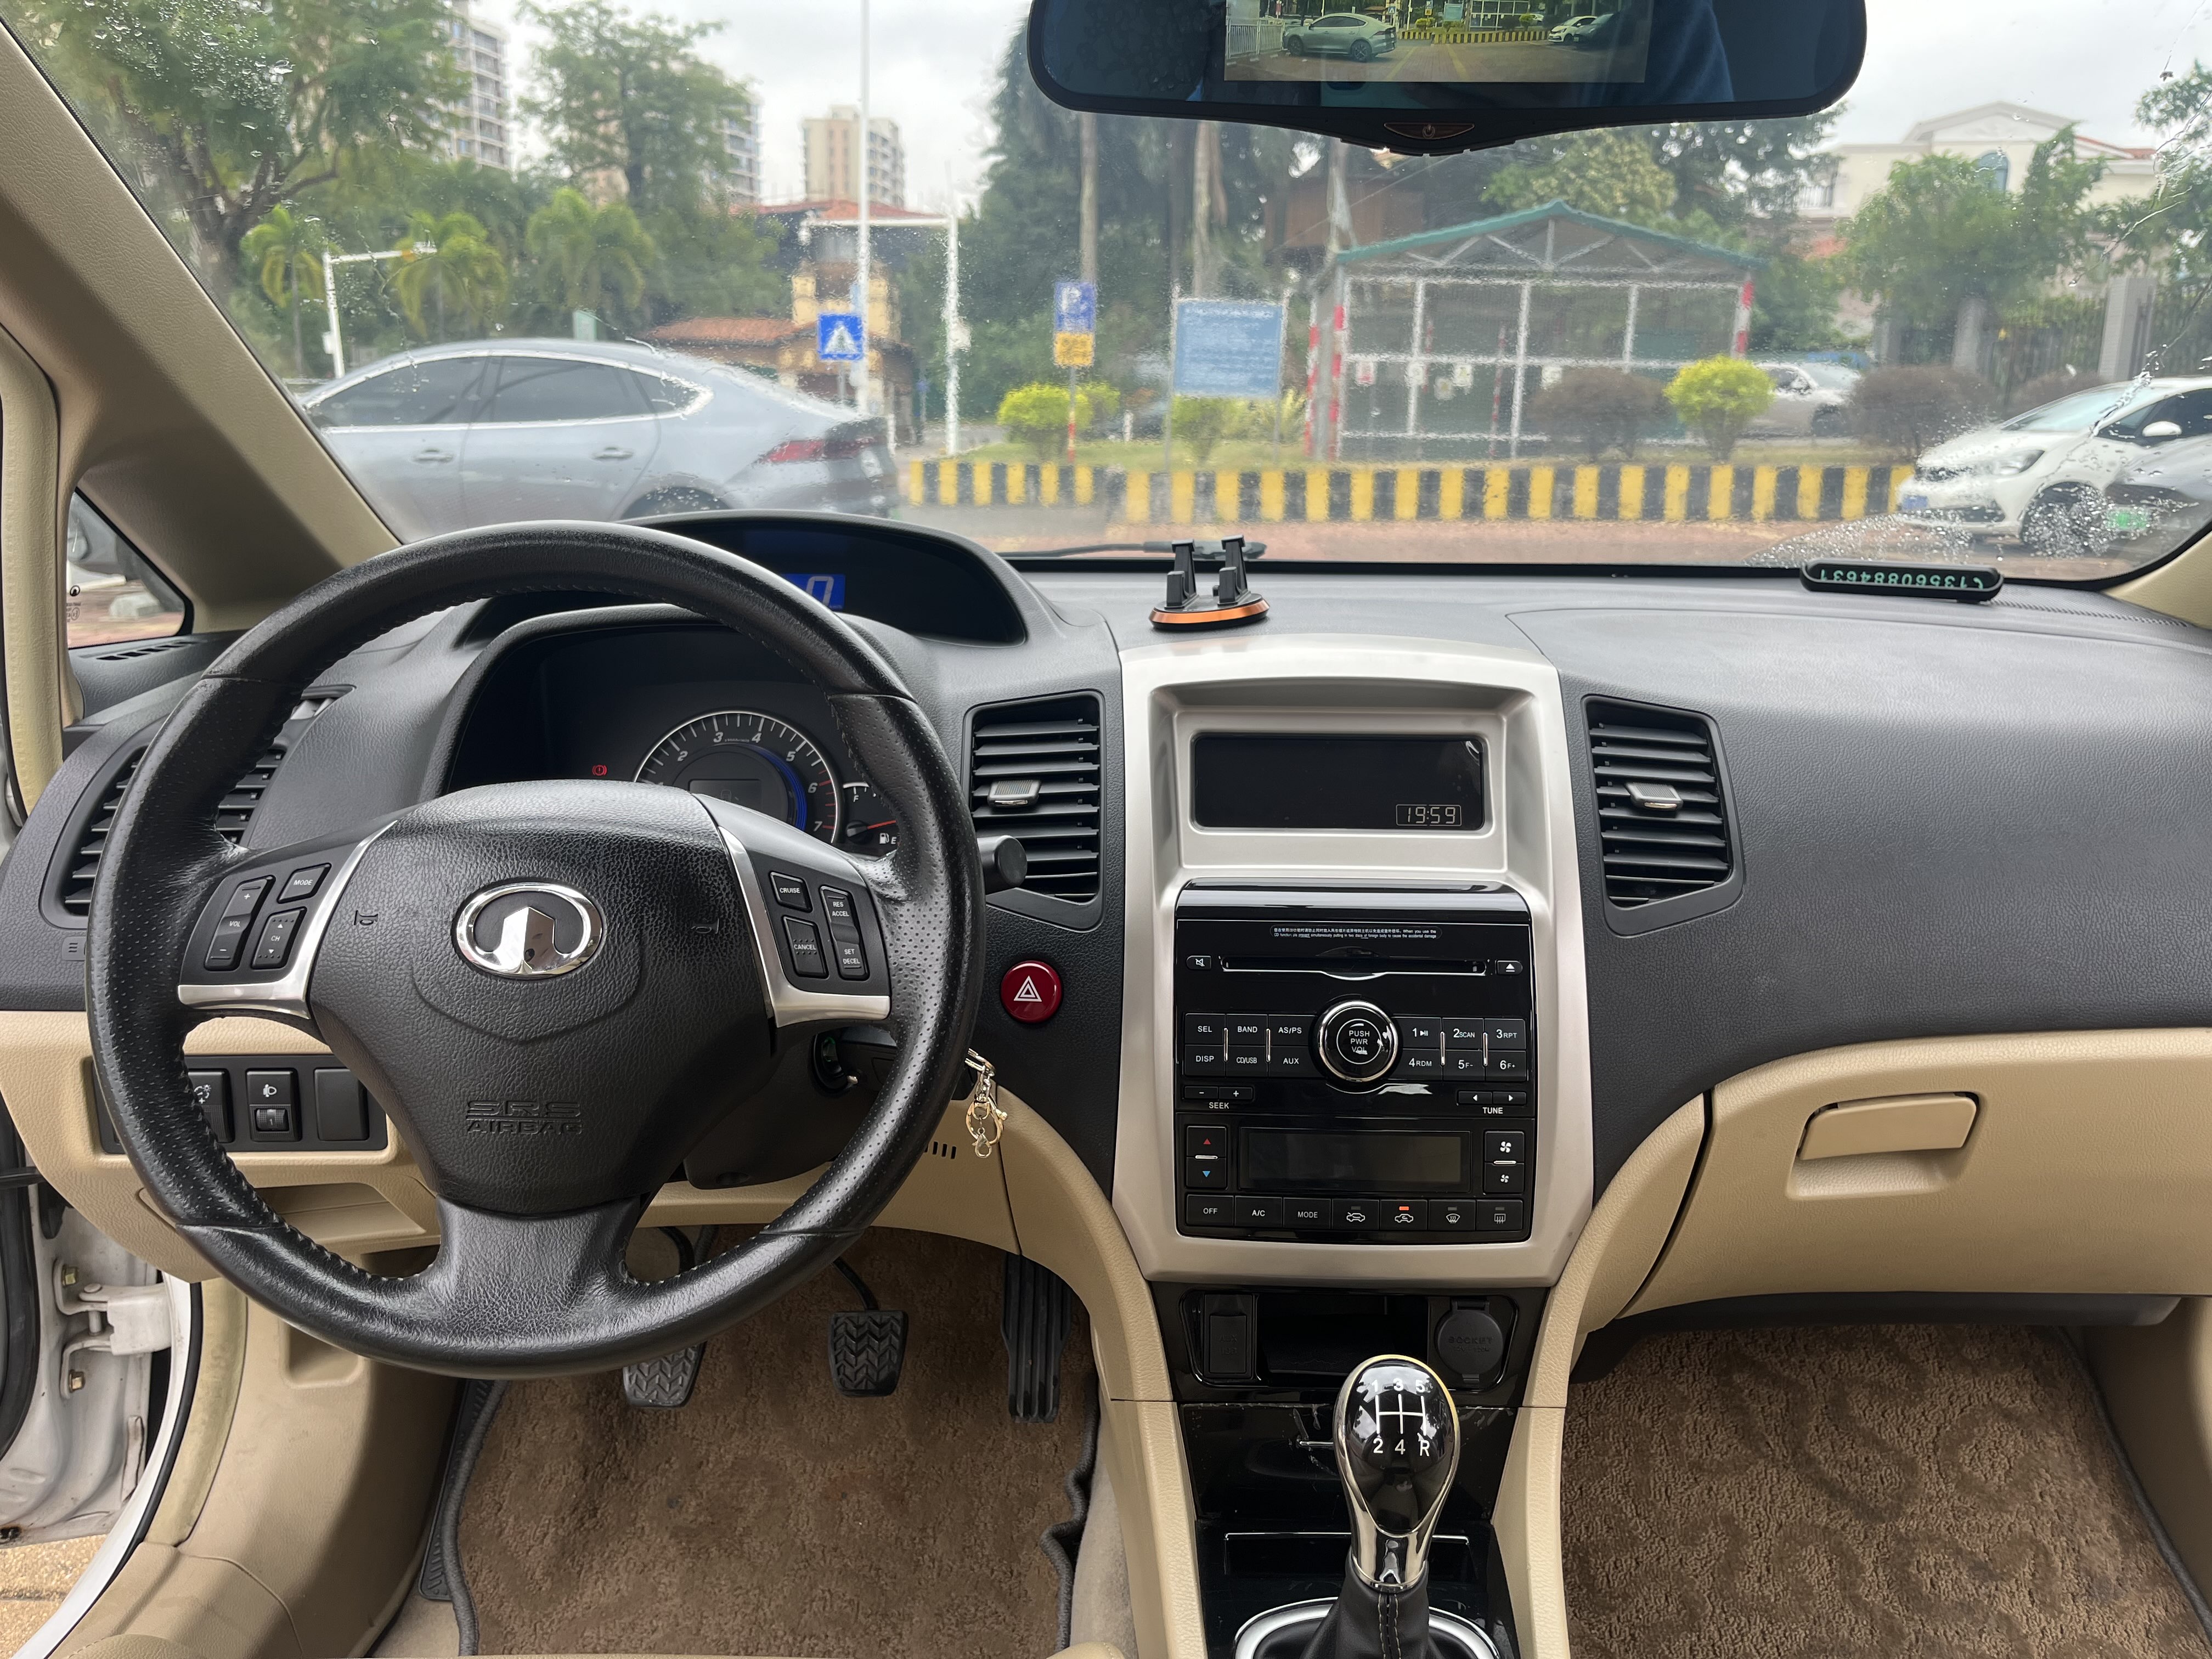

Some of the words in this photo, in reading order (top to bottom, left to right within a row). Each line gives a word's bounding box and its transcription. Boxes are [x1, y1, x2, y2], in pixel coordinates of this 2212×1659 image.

[1061, 287, 1081, 312] P
[1820, 569, 1967, 588] 13560884631
[714, 732, 723, 743] 3
[752, 733, 761, 743] 4
[678, 751, 688, 761] 2
[787, 751, 794, 761] 5
[808, 783, 817, 793] 6
[1407, 807, 1457, 824] 19:59
[814, 822, 822, 831] 7
[1413, 1028, 1417, 1037] 1
[467, 1100, 582, 1116] SRS
[467, 1120, 582, 1135] AIRBAG
[1448, 1336, 1492, 1344] SOCKET
[1372, 1380, 1379, 1391] 1
[1394, 1379, 1403, 1391] 3
[1415, 1380, 1425, 1392] 5
[1373, 1438, 1383, 1453] 2
[1395, 1440, 1405, 1454] 4
[1420, 1441, 1429, 1456] R
